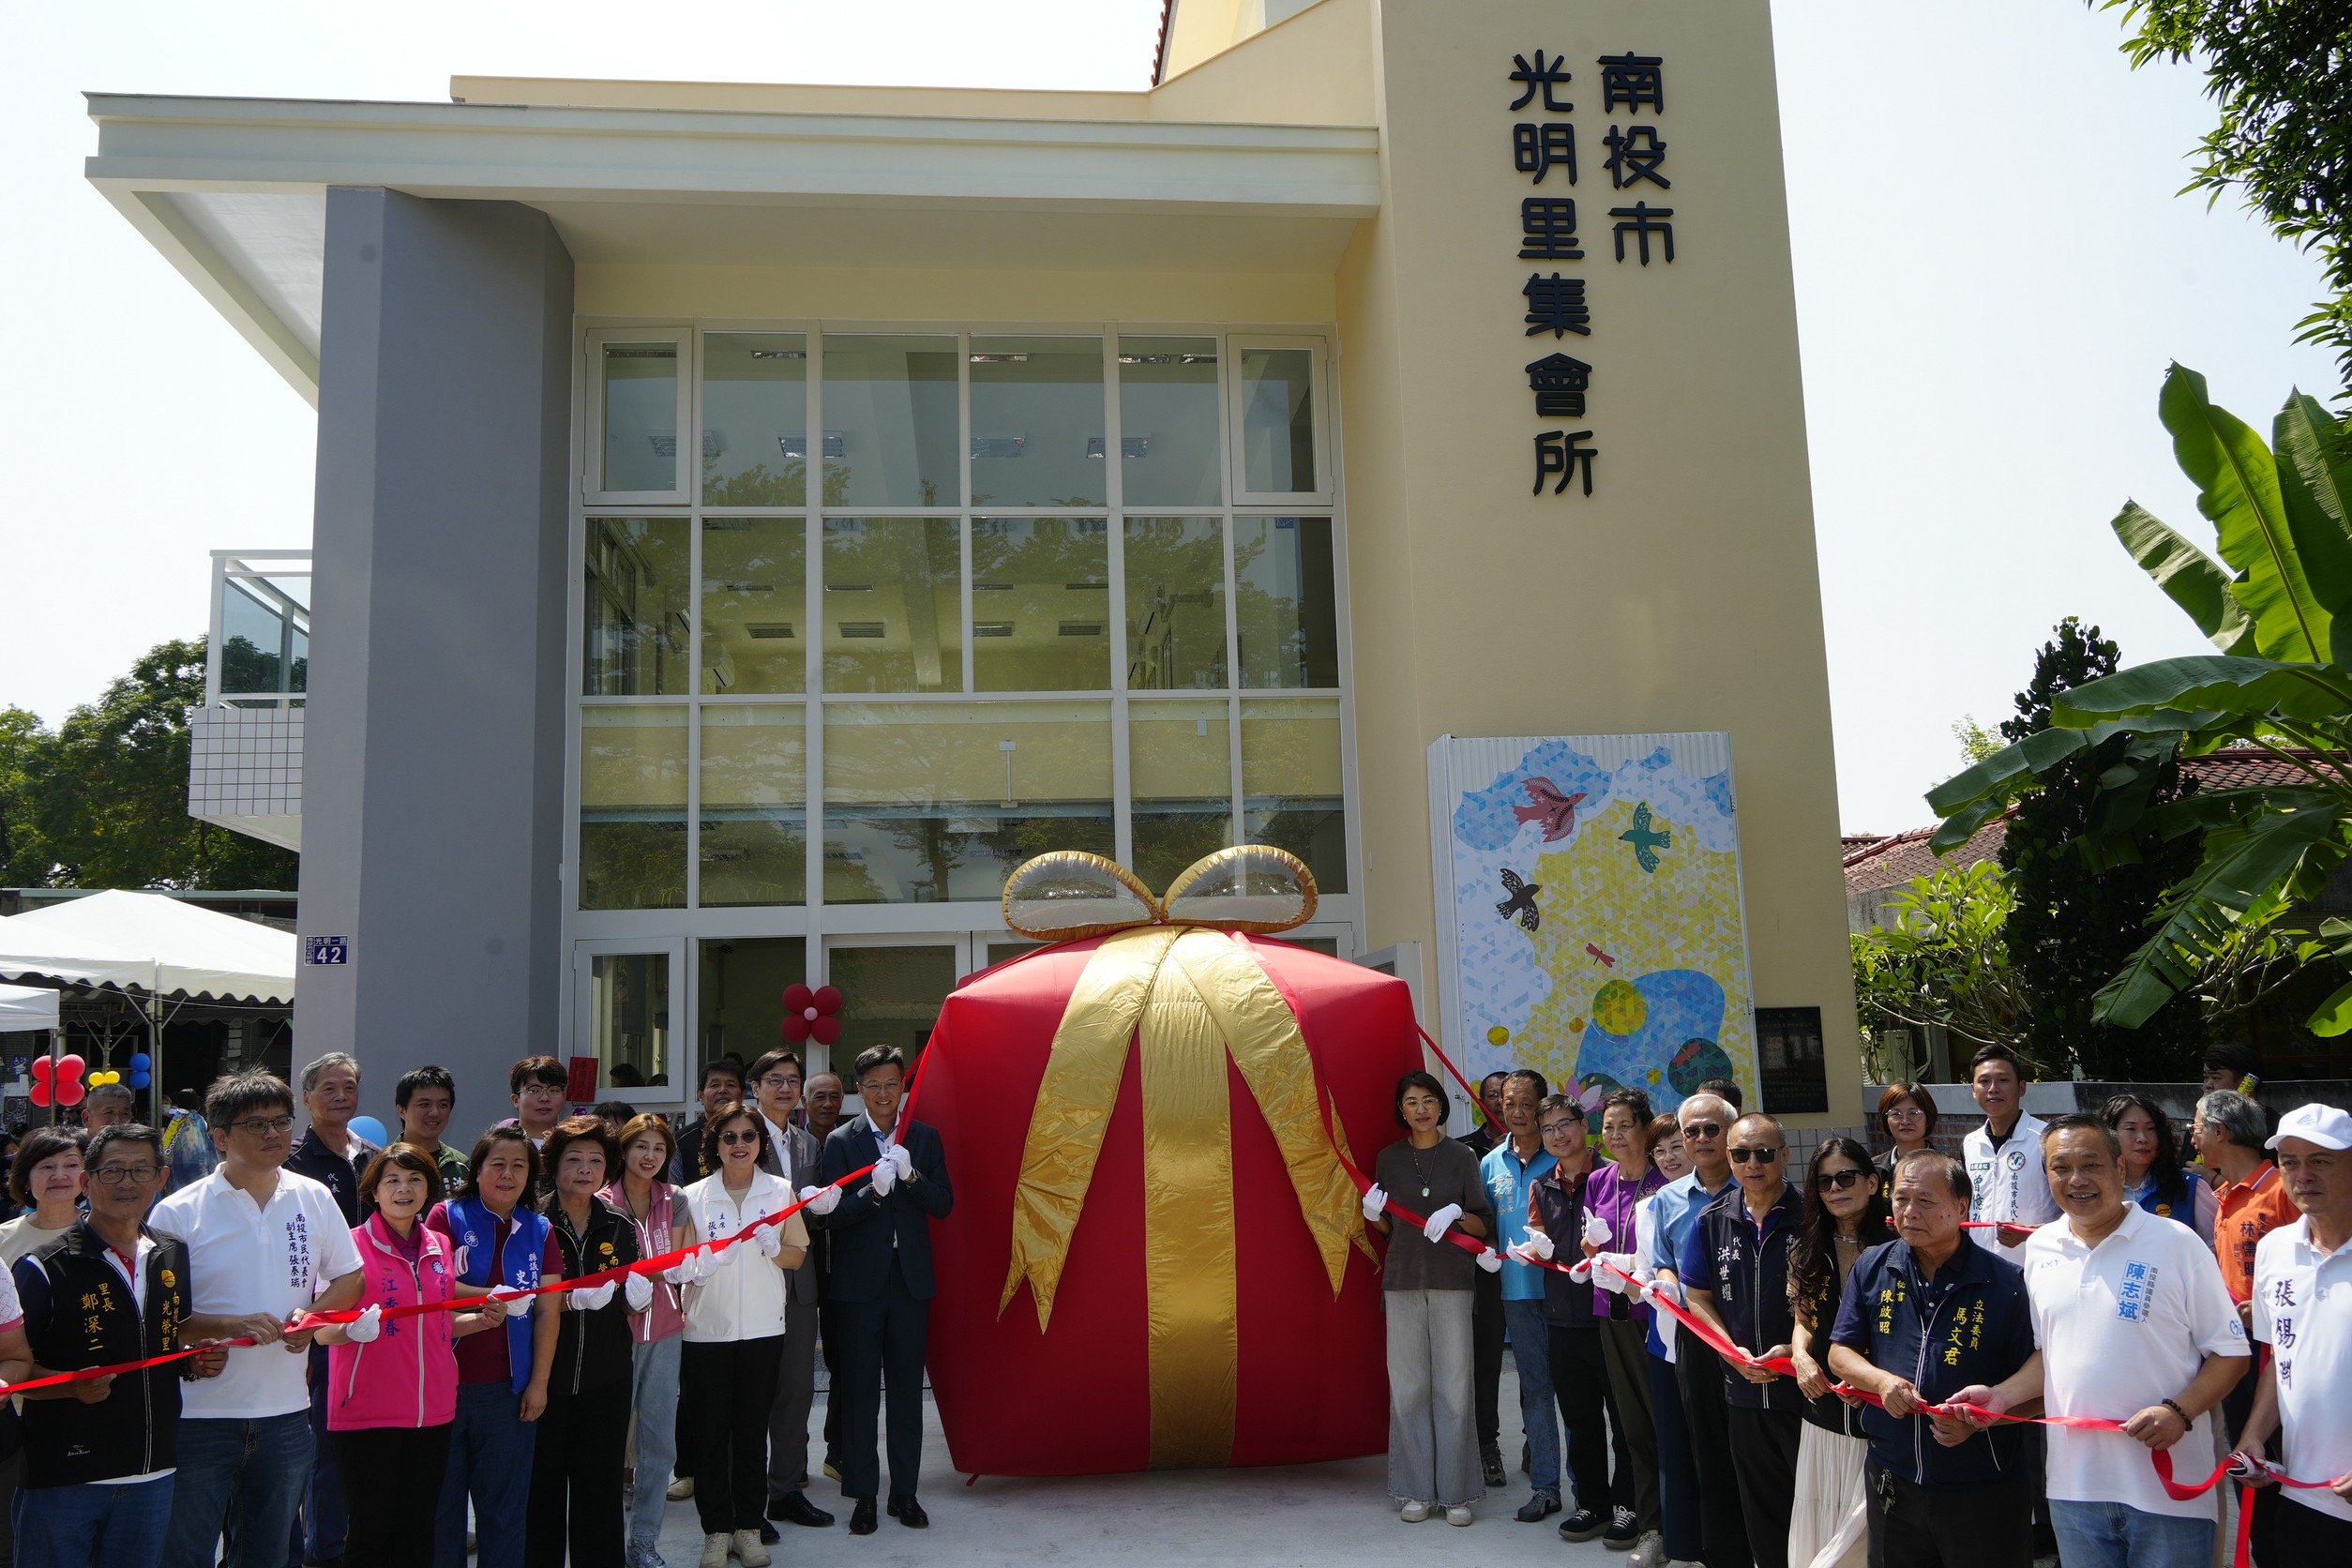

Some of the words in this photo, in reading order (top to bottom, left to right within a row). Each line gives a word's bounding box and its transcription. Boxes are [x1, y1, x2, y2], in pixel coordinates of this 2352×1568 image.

[1597, 51, 1677, 267] 南投市
[1508, 49, 1598, 498] 光明里集會所
[317, 946, 340, 964] 42
[2011, 1172, 2019, 1221] 南投市民代
[295, 1213, 309, 1289] 南投市民代表會
[1731, 1236, 1742, 1260] 代表
[98, 1282, 116, 1312] 里長
[1896, 1280, 1906, 1303] 秘書
[2118, 1262, 2147, 1320] 陳志斌
[82, 1293, 104, 1350] 鄭深二
[161, 1300, 172, 1351] 光榮里
[1943, 1306, 1968, 1366] 馬文君
[1969, 1299, 1985, 1351] 立法委員
